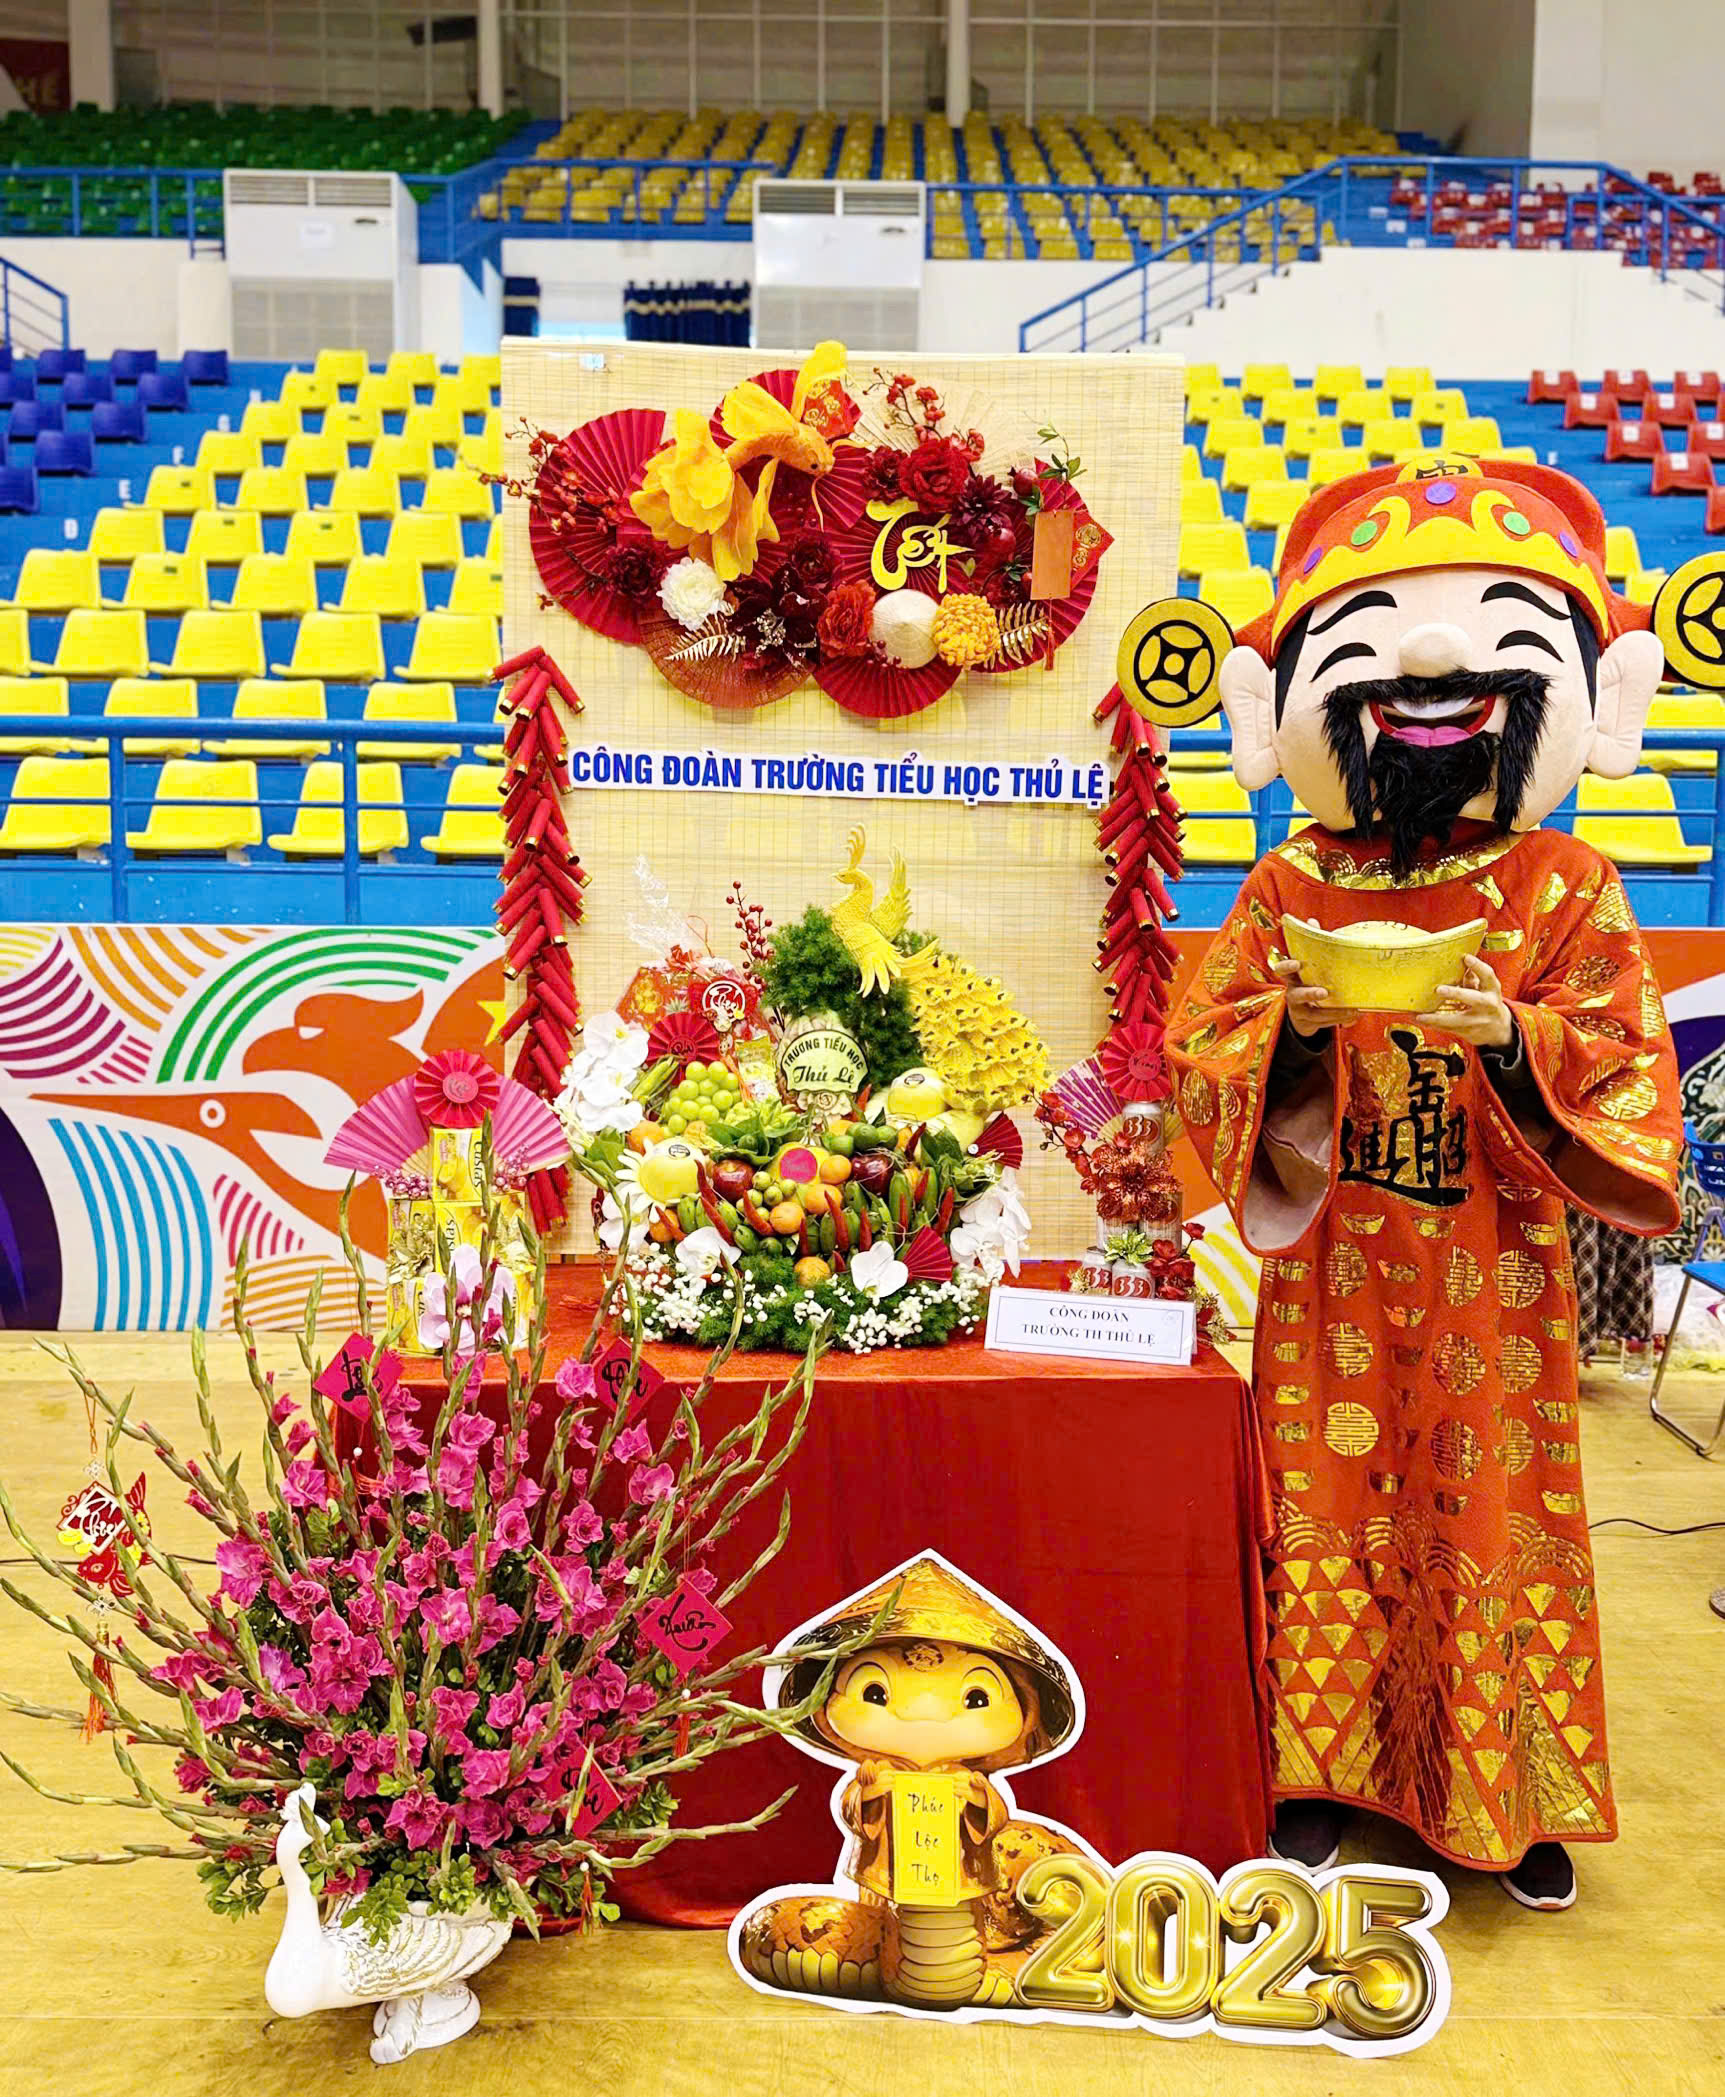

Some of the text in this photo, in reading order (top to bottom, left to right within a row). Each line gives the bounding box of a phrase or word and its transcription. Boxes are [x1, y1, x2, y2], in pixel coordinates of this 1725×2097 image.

[573, 746, 1104, 806] CÔNG ĐOÀN TRƯỜNG TIỂU HỌC THỦ LỆ
[792, 1065, 855, 1089] Thủ Lệ
[1127, 1114, 1152, 1138] 333
[1118, 1275, 1144, 1297] 333
[1049, 1305, 1088, 1320] CÔNG
[1083, 1328, 1102, 1340] TH
[1104, 1328, 1134, 1343] THỦ
[1137, 1332, 1157, 1347] LỆ
[907, 1793, 944, 1813] Phúc
[911, 1863, 940, 1886] Thọ
[1015, 1853, 1436, 2041] 2025
